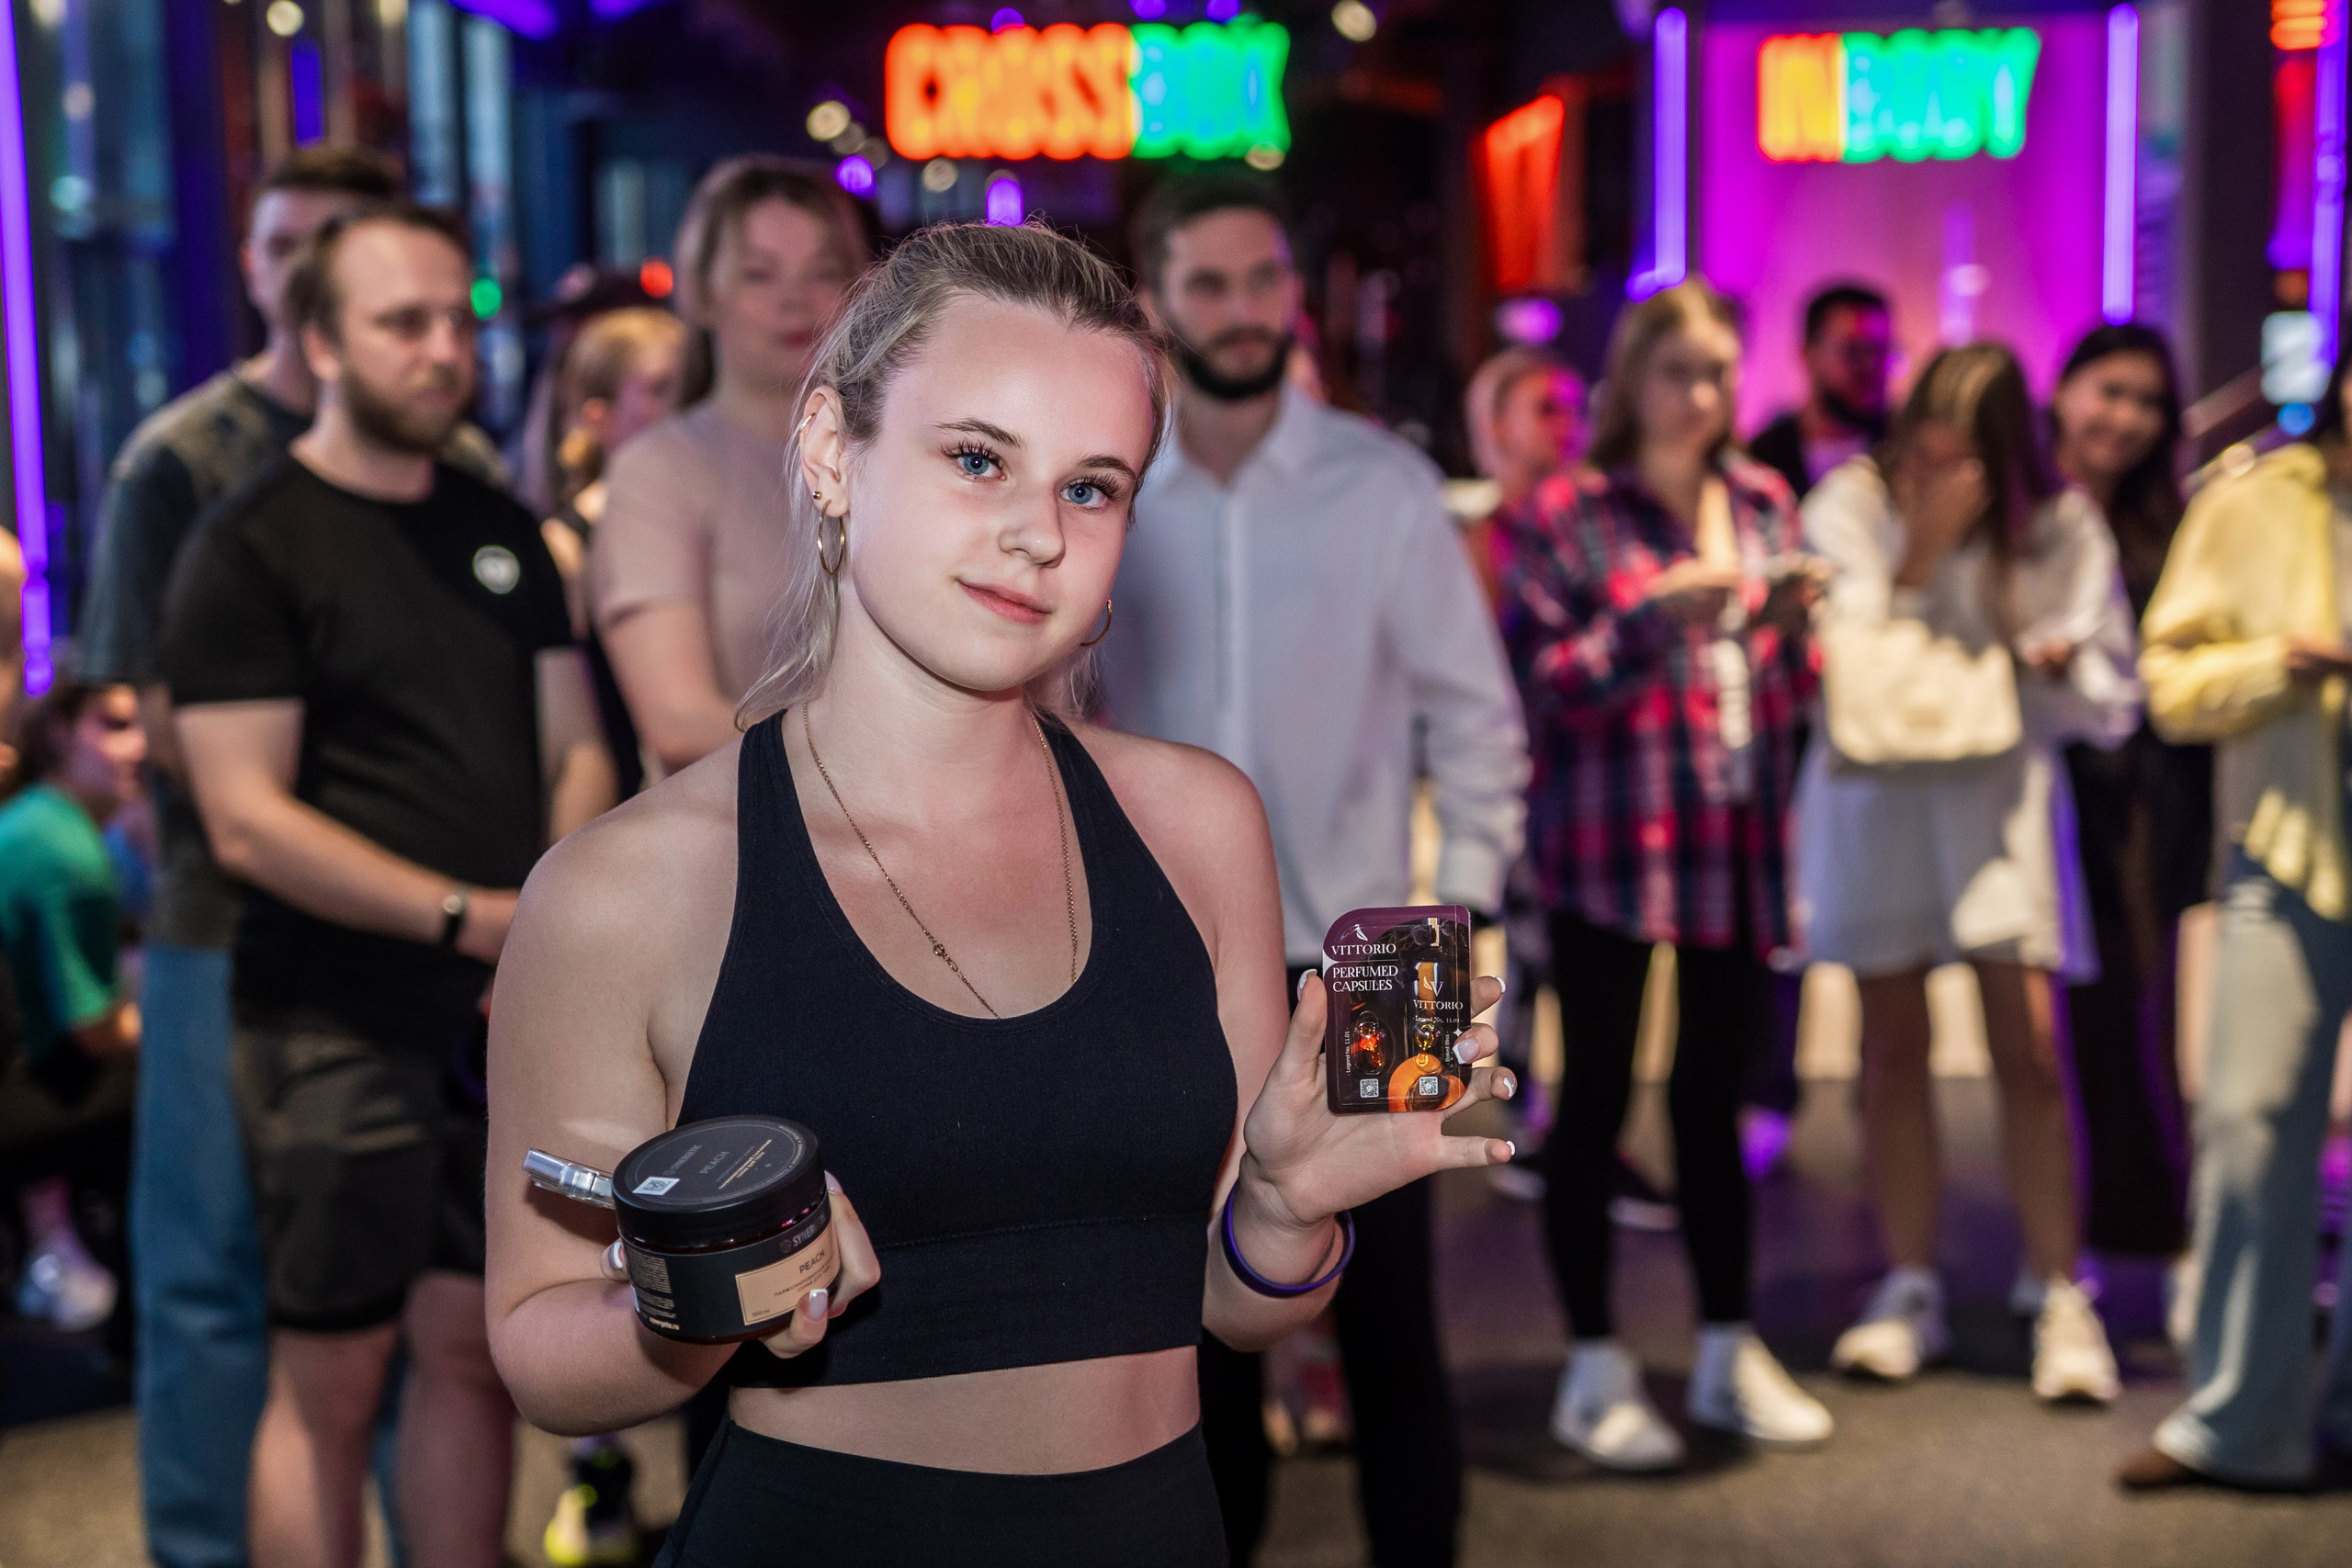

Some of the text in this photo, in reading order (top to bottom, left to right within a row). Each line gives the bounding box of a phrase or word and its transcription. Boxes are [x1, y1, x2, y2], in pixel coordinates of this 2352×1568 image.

[1331, 943, 1396, 956] VITTORIO
[1332, 965, 1398, 979] PERFUMED
[1332, 979, 1393, 993] CAPSULES
[1413, 999, 1464, 1010] VITTORIO
[699, 1151, 729, 1175] PEACH
[798, 1249, 825, 1274] PEACH
